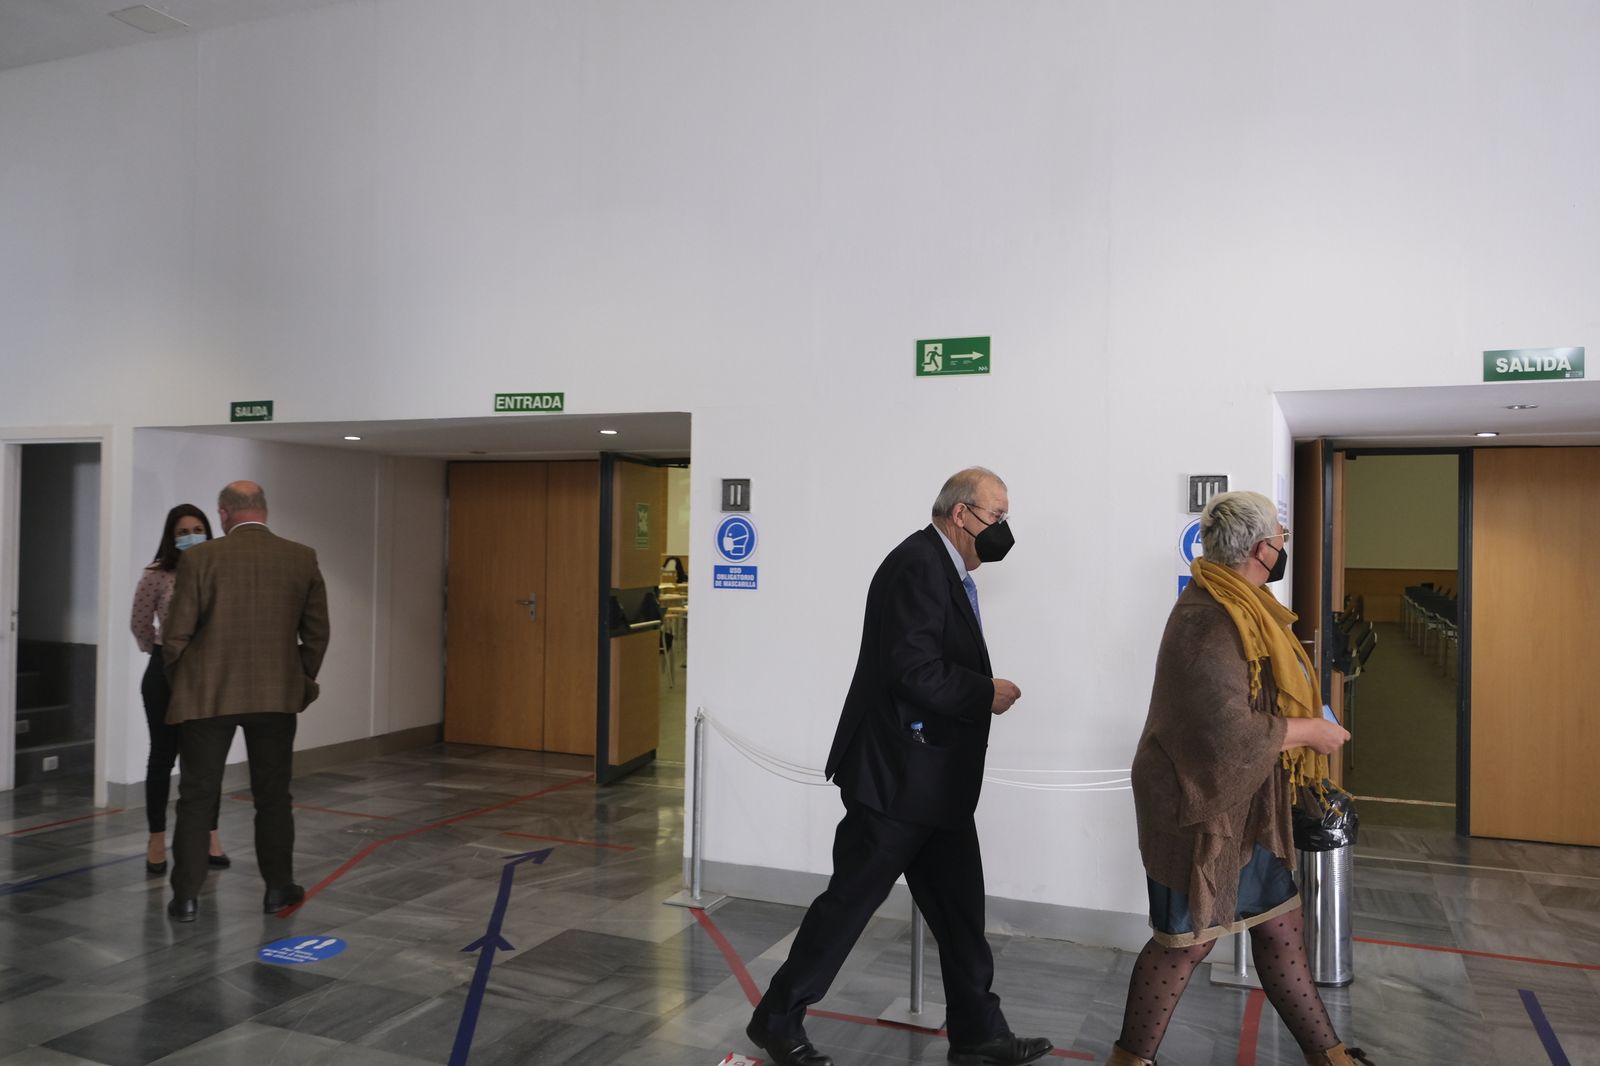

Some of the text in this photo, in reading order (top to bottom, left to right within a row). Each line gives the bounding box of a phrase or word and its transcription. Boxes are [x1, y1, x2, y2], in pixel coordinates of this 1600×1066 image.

[1495, 356, 1572, 373] SALIDA
[496, 395, 562, 409] ENTRADA
[234, 406, 269, 417] SALIDA
